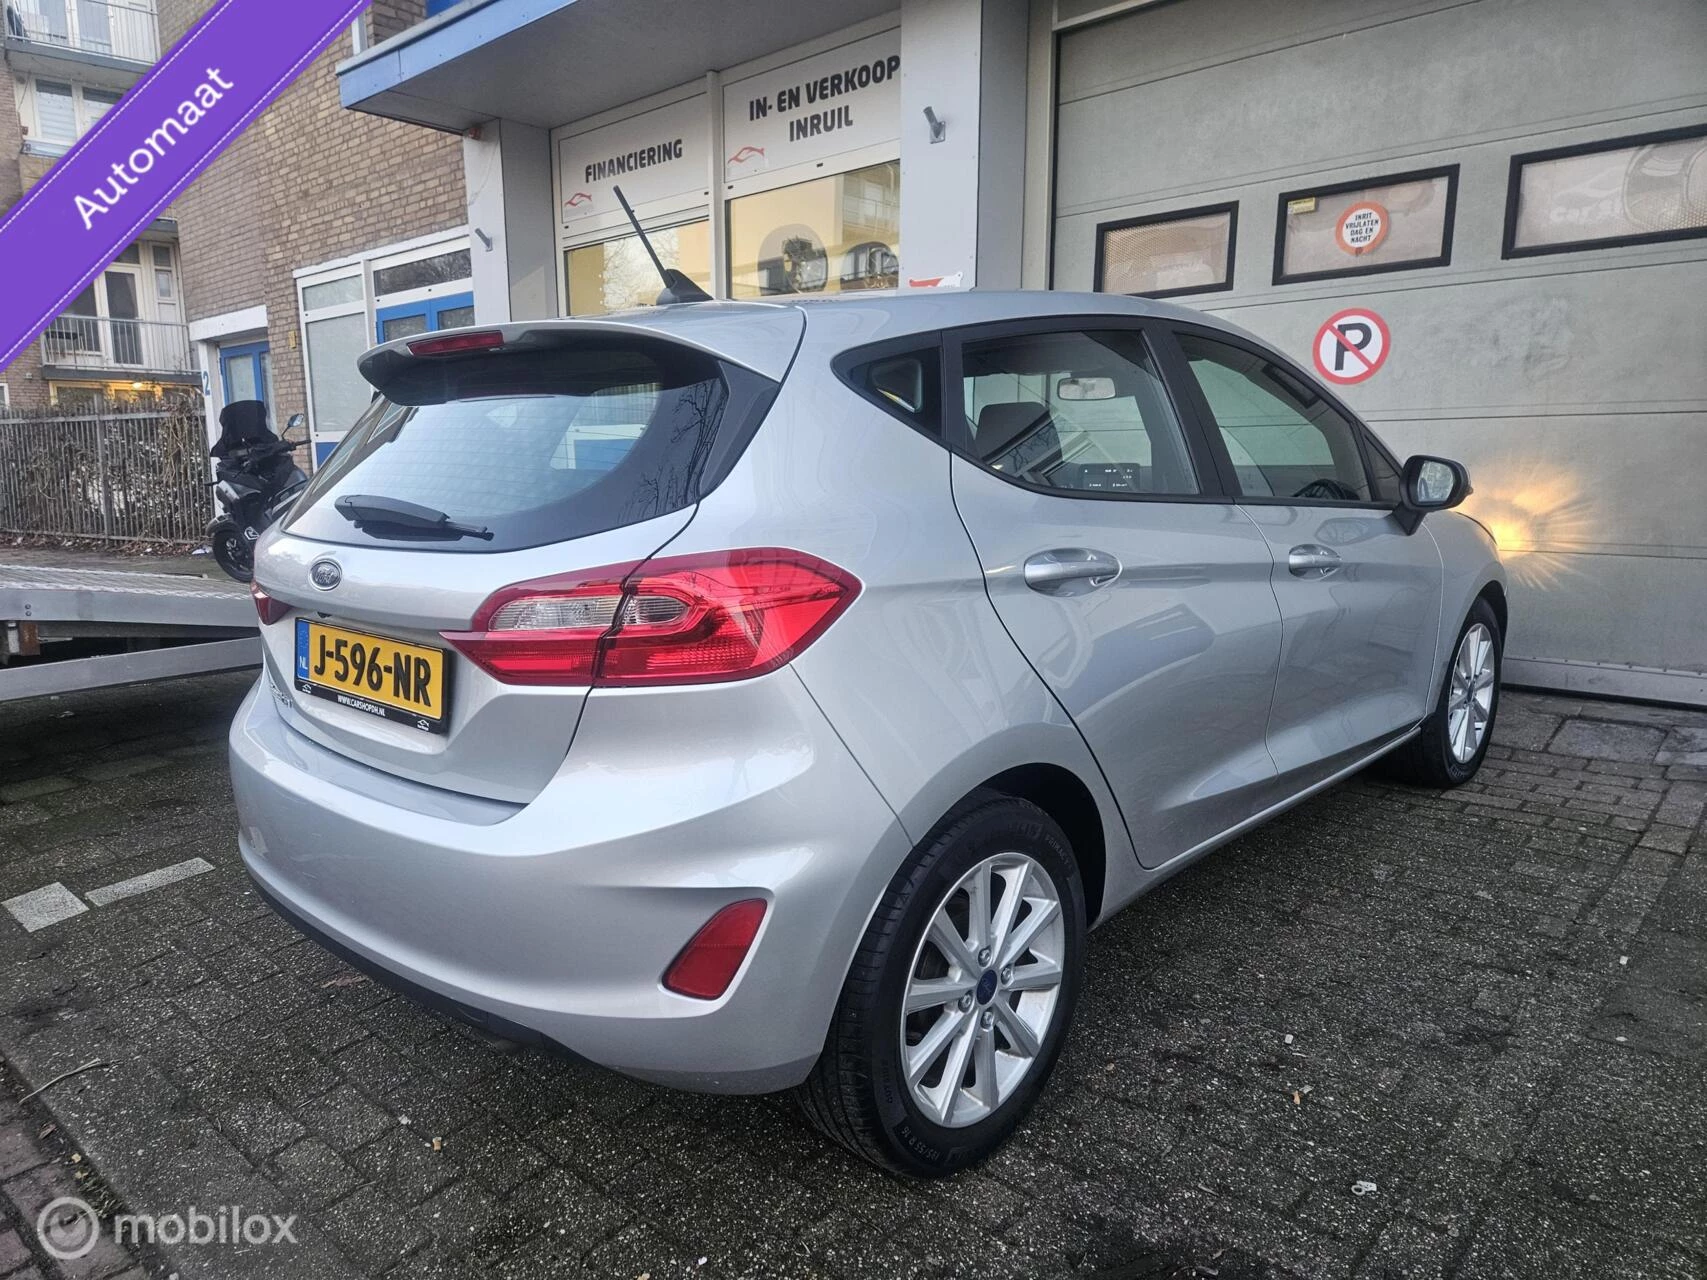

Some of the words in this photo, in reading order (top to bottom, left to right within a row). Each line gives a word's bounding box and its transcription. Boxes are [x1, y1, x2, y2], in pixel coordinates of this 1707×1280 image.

[749, 97, 773, 121] IN-
[777, 86, 800, 112] EN
[805, 55, 900, 104] VERKOOP
[789, 105, 853, 142] INRUIL
[585, 139, 683, 183] FINANCIERING
[1346, 219, 1379, 229] VRIJLATEN
[1355, 212, 1372, 221] INRIT
[1351, 235, 1371, 243] NACHT
[1334, 322, 1373, 371] P
[203, 371, 211, 396] 2
[299, 655, 308, 670] NL
[314, 635, 431, 707] J-596-NR
